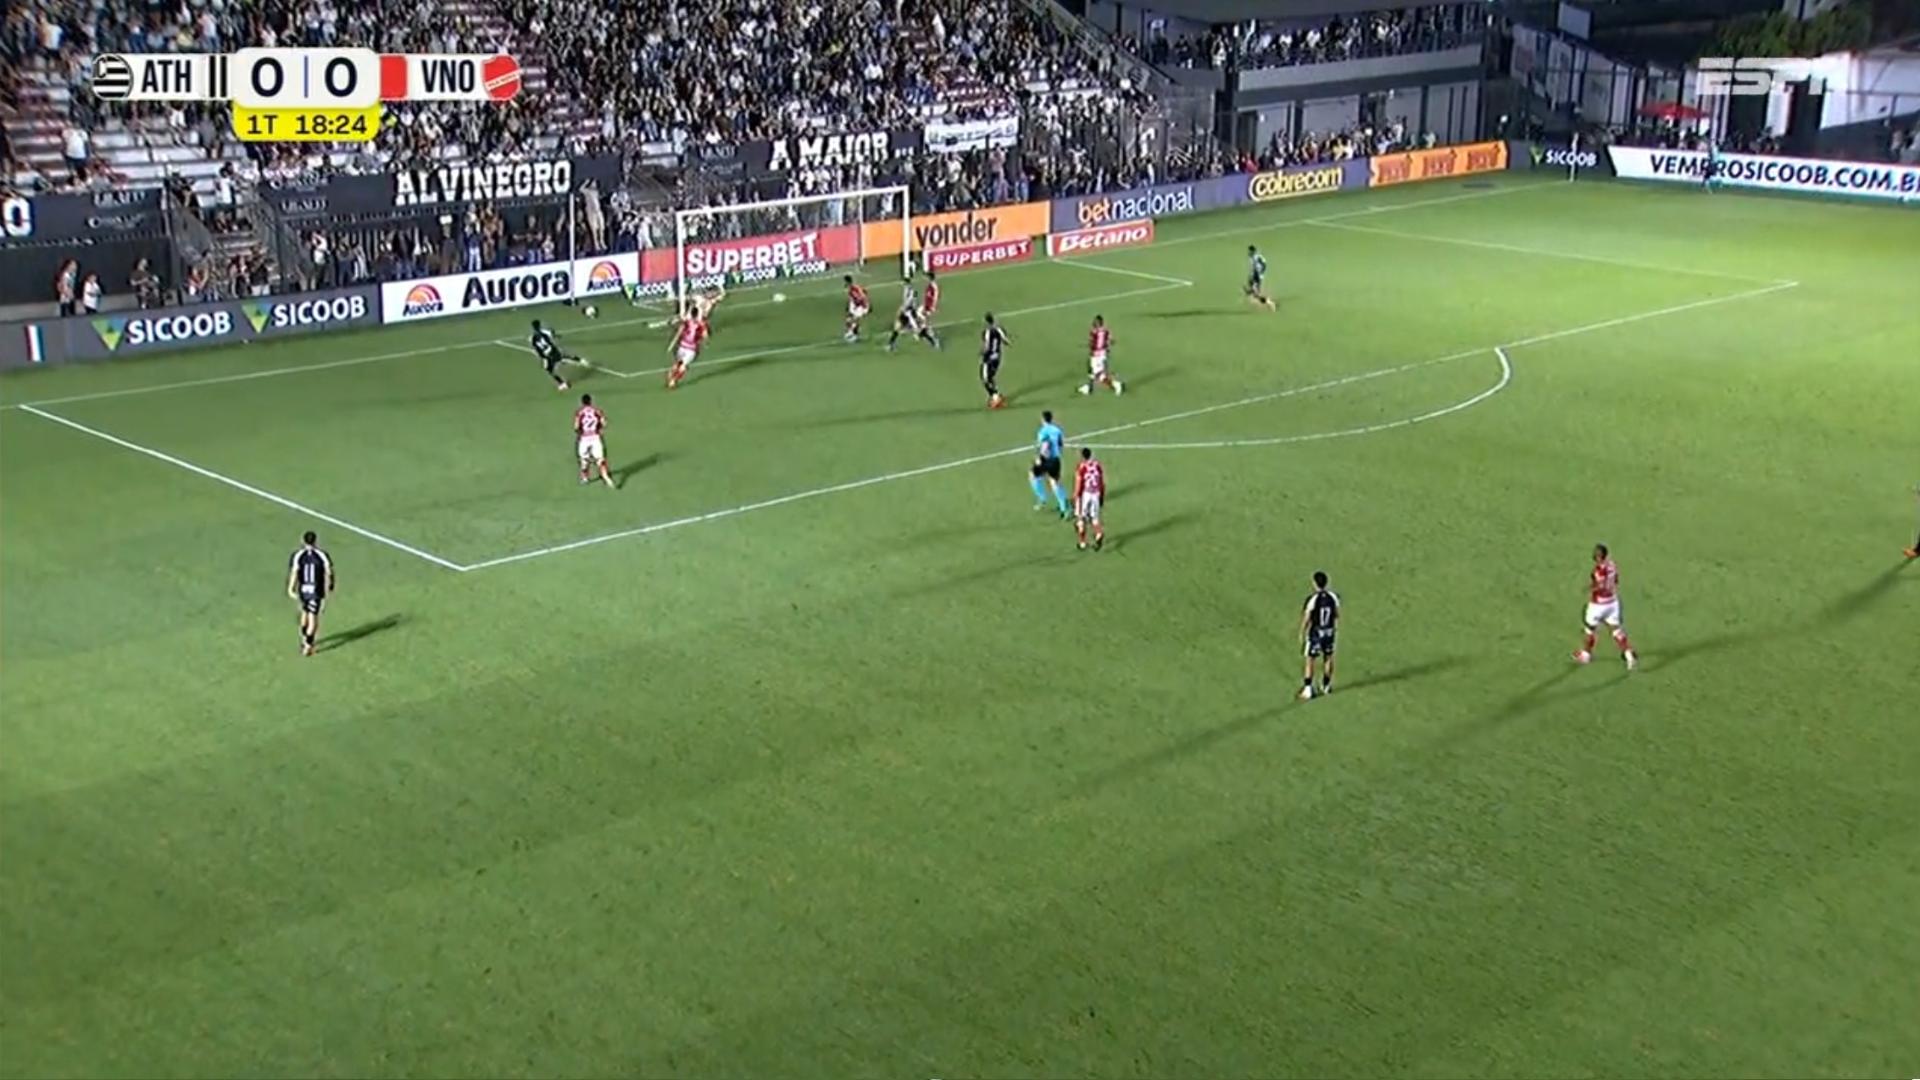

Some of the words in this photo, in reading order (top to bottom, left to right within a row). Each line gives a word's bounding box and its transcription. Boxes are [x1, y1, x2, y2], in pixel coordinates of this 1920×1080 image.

[769, 139, 793, 170] A
[798, 130, 889, 166] MAIOR
[1546, 149, 1597, 167] SICOOB
[396, 160, 571, 205] ALVINEGRO
[1078, 184, 1194, 225] betnacional
[915, 212, 998, 248] yonder
[1058, 226, 1148, 252] Betano
[687, 234, 817, 273] SUPERBET
[932, 240, 1029, 267] SUPERBET
[461, 269, 571, 308] Aurora
[273, 295, 366, 327] SICOOB
[402, 299, 444, 317] Aurora
[127, 310, 232, 345] SICOOB
[304, 563, 315, 583] 11
